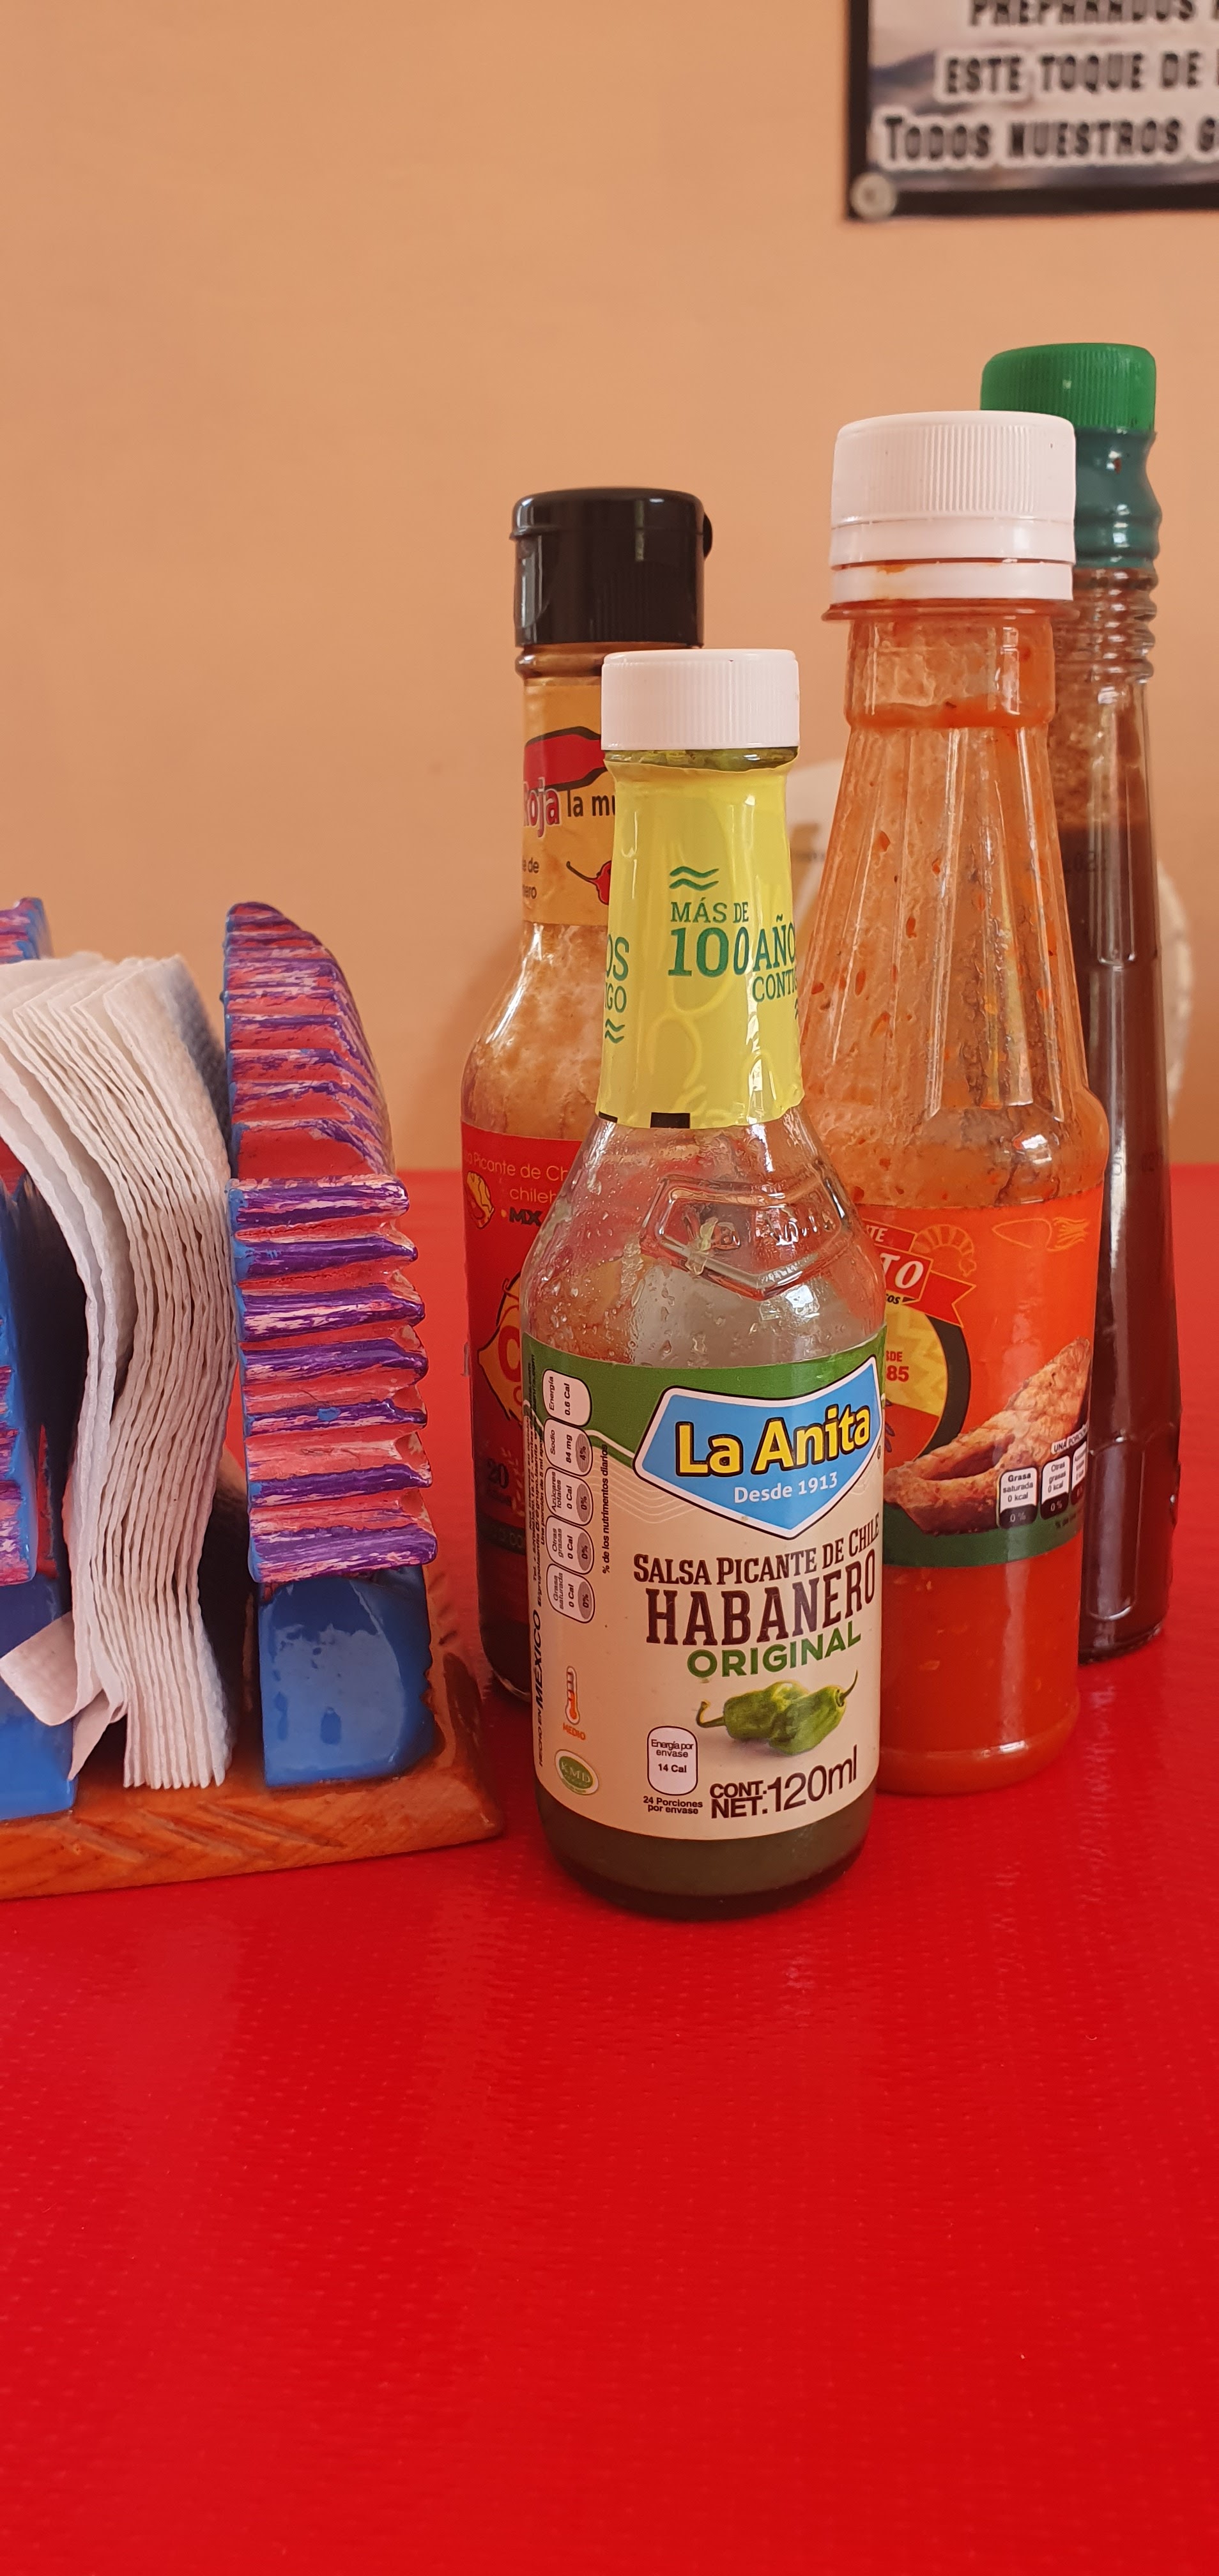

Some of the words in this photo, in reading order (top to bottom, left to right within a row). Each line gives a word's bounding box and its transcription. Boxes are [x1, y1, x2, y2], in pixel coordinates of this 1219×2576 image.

[946, 56, 1022, 93] ESTE
[1040, 52, 1144, 93] TOQUE
[1160, 50, 1202, 89] DE
[1009, 118, 1181, 158] NUESTROS
[567, 790, 585, 817] la
[670, 897, 728, 924] MÁS
[733, 901, 749, 923] DE
[668, 926, 749, 978] 100
[520, 1163, 541, 1180] de
[566, 1434, 572, 1450] mg
[675, 1421, 744, 1477] La
[751, 1404, 871, 1475] Anita
[566, 1451, 572, 1464] 84
[600, 1444, 609, 1476] diarios
[734, 1484, 793, 1504] Desde
[797, 1471, 839, 1496] 1913
[1002, 1482, 1034, 1494] saturada
[1008, 1473, 1032, 1483] Grasa
[601, 1478, 609, 1534] nutrimentos
[1014, 1492, 1029, 1501] kcal
[602, 1535, 610, 1549] los
[633, 1552, 712, 1586] SALSA
[716, 1547, 818, 1586] PICANTE
[822, 1537, 845, 1566] DE
[848, 1512, 880, 1554] CHILE
[602, 1551, 610, 1563] de
[645, 1549, 877, 1646] HABANERO
[533, 1609, 544, 1709] MÉXICO
[686, 1620, 862, 1678] ORIGINAL
[650, 1738, 680, 1751] Energía
[680, 1742, 694, 1751] por
[656, 1749, 689, 1758] envase
[658, 1763, 669, 1772] 14
[671, 1764, 687, 1773] Cal
[767, 1744, 857, 1814] 120ml
[643, 1795, 654, 1804] 24
[656, 1797, 703, 1808] Porciones
[647, 1804, 664, 1813] por
[665, 1806, 699, 1814] envase
